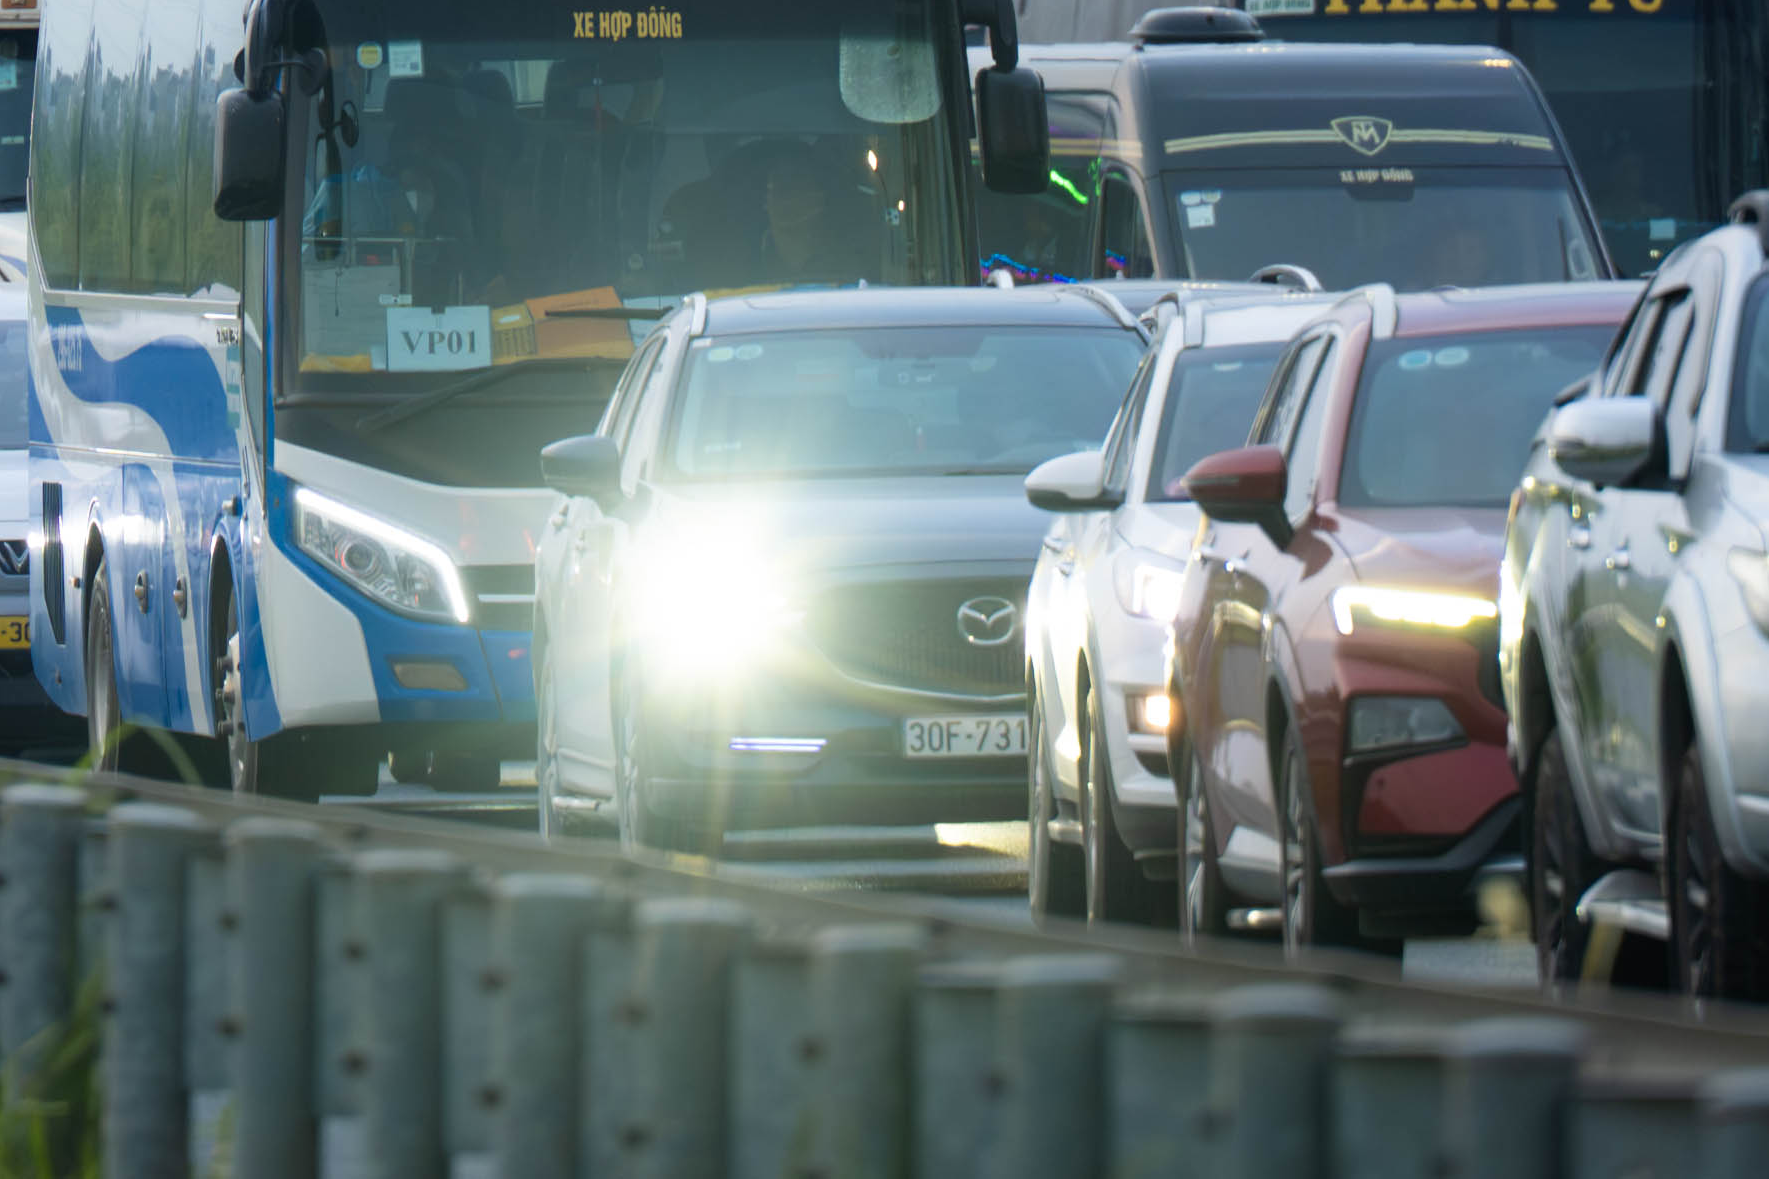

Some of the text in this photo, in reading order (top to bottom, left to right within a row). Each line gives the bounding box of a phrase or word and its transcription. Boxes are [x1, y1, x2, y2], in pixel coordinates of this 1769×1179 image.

[573, 11, 595, 38] XE
[599, 10, 633, 42] HỢP
[401, 330, 477, 355] VP01
